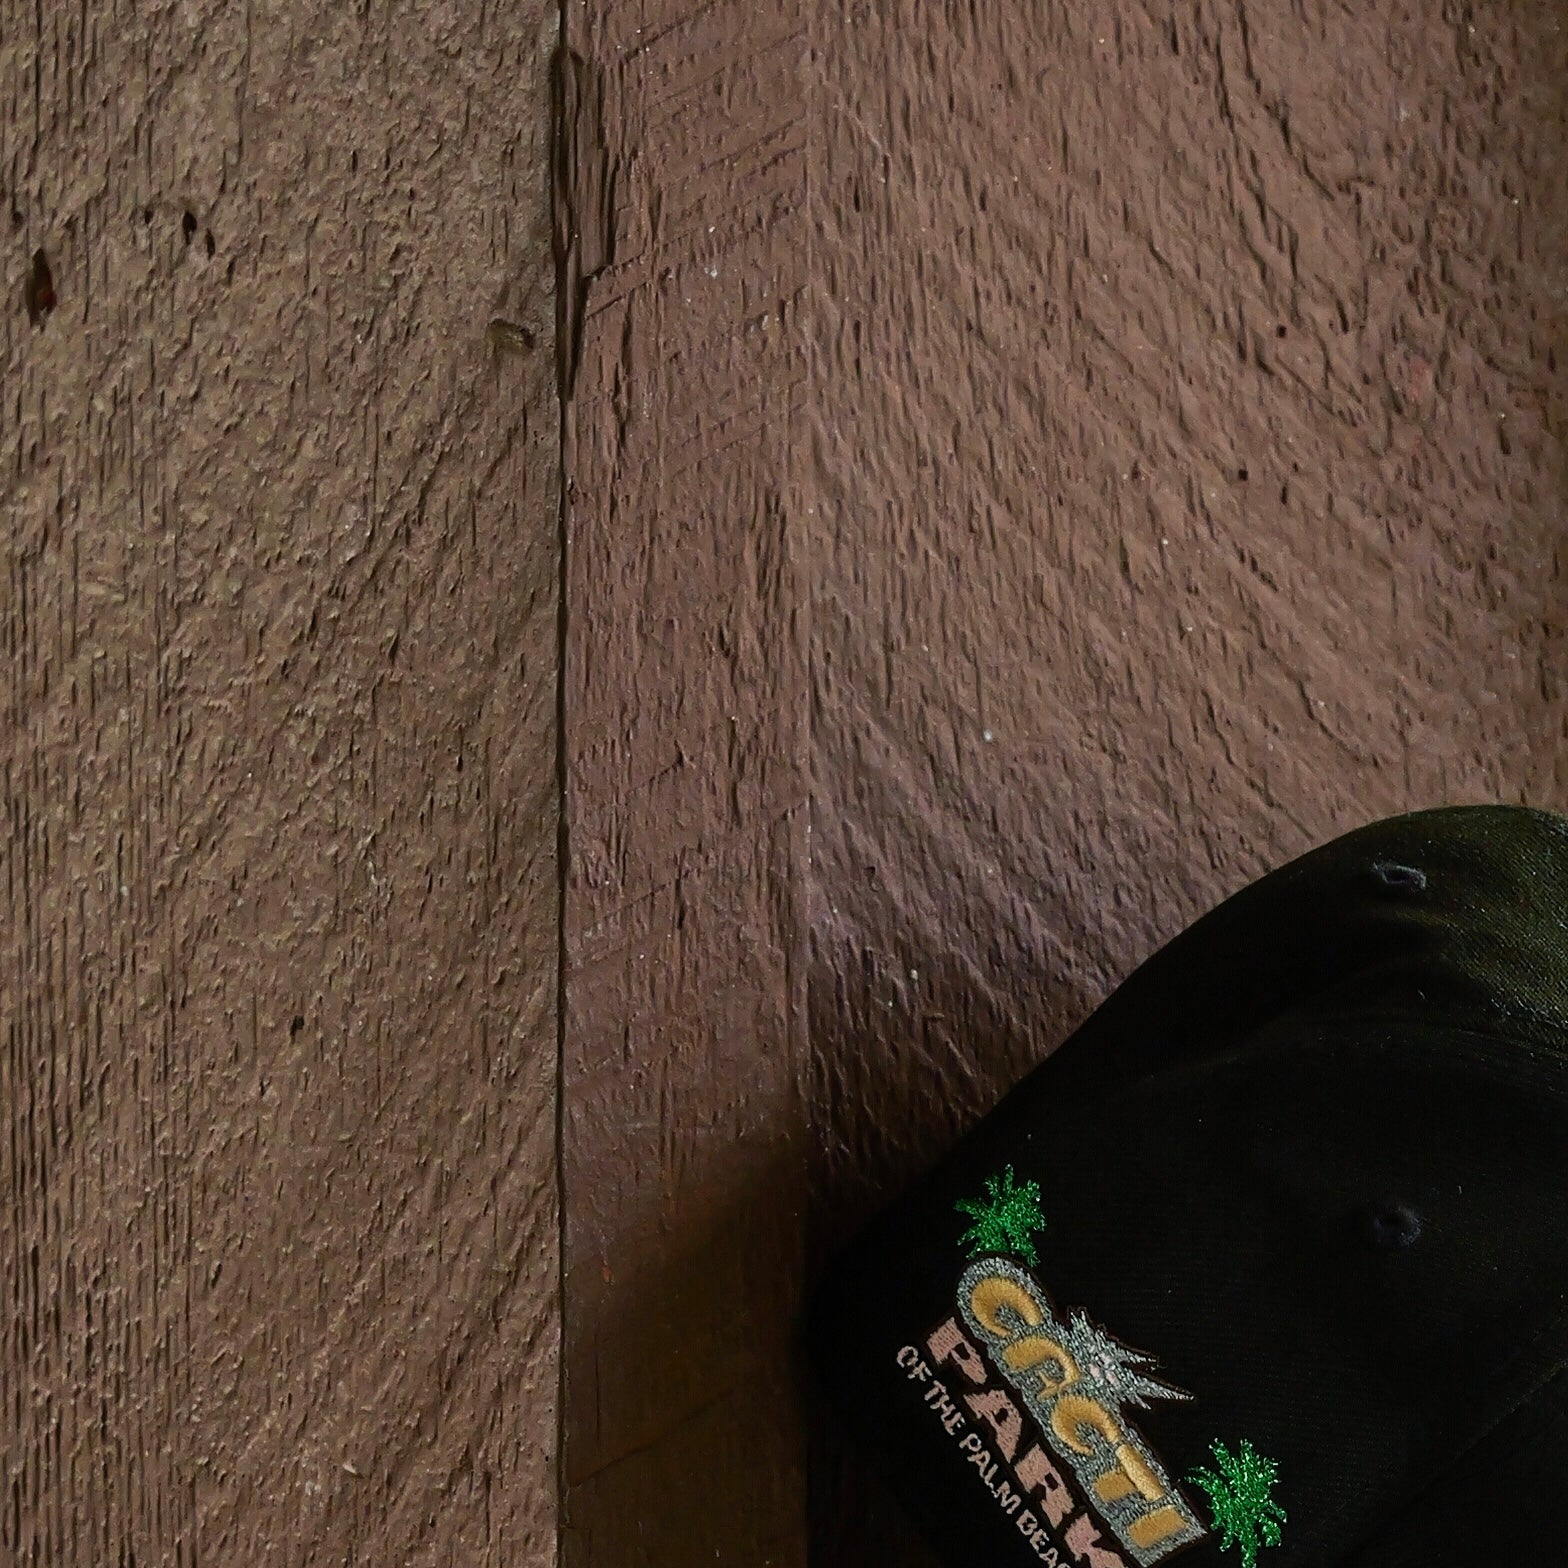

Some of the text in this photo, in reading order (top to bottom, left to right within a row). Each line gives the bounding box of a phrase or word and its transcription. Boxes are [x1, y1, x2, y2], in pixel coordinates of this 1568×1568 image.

[897, 1345, 932, 1382] OF
[924, 1380, 965, 1436] THE
[959, 1433, 1022, 1514] PALM
[971, 1277, 1190, 1549] CACTI
